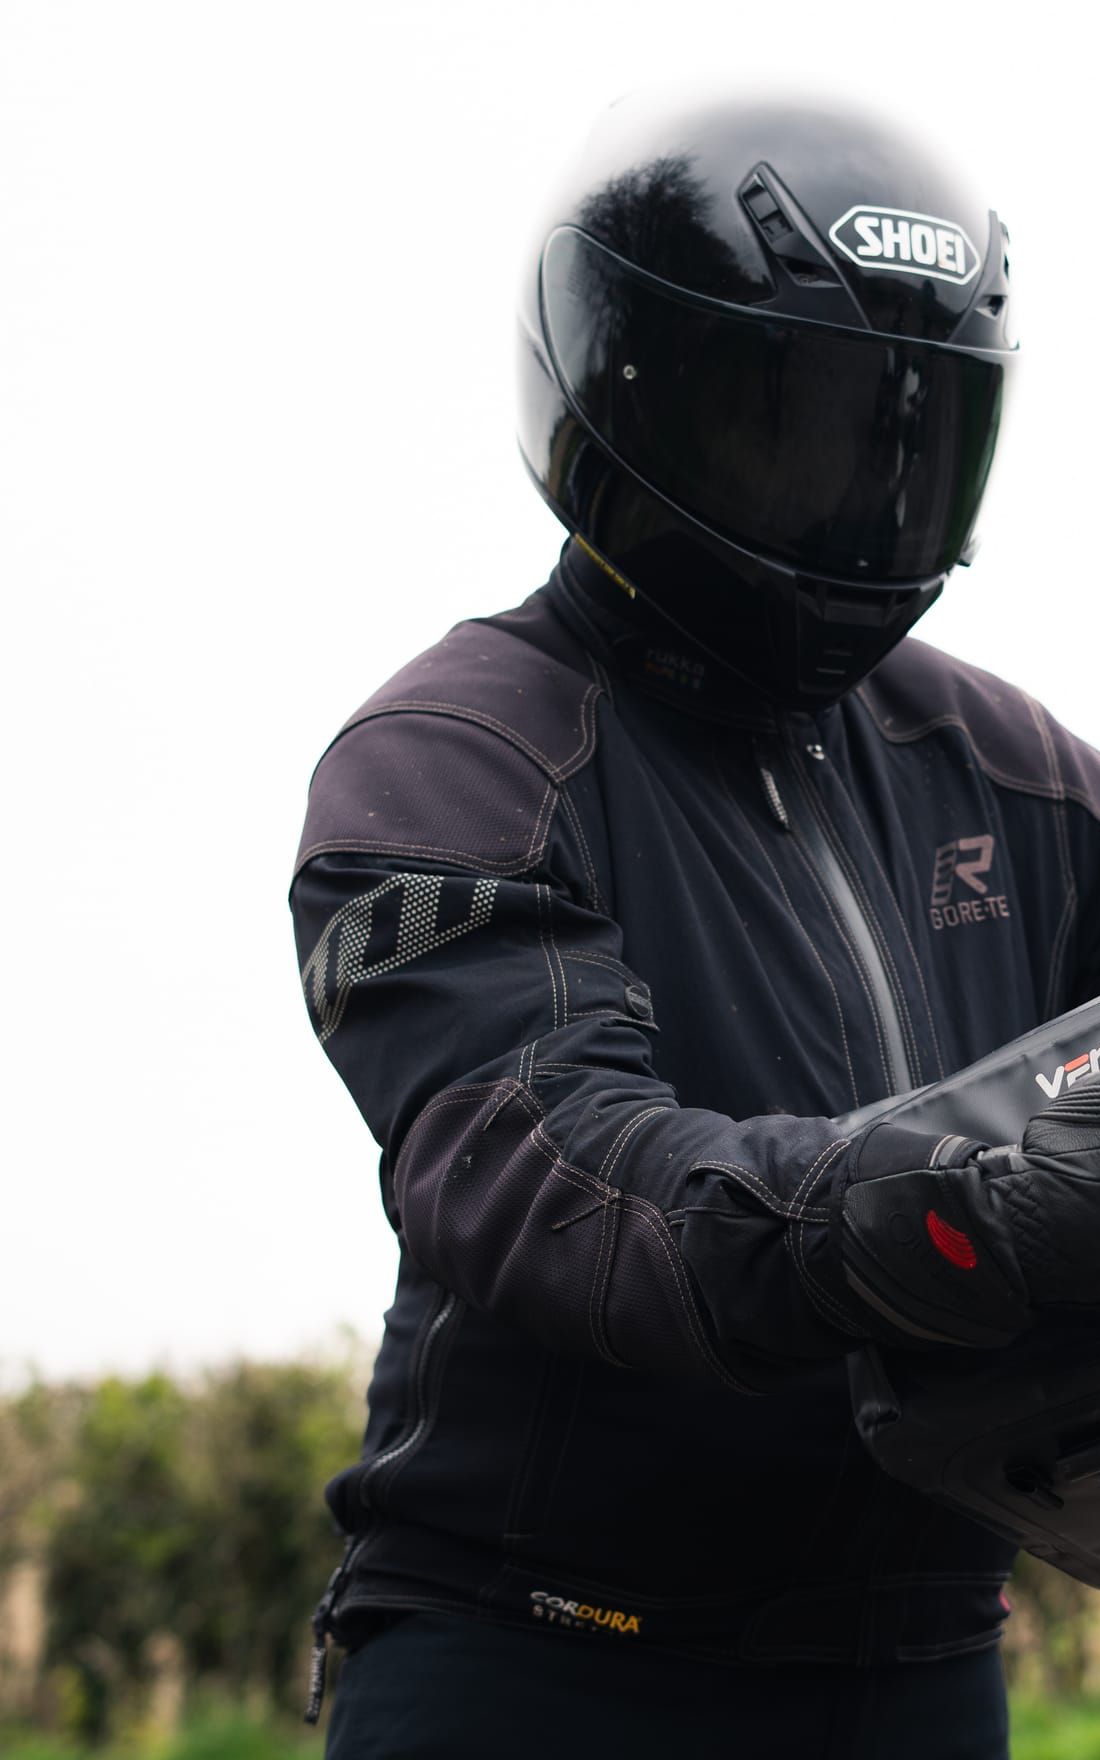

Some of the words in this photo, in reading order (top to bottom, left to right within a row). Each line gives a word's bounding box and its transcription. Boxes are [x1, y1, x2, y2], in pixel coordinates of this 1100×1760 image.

[854, 215, 966, 275] SHOEI
[930, 895, 1010, 930] GORE-TE
[530, 1591, 641, 1633] CORDURA
